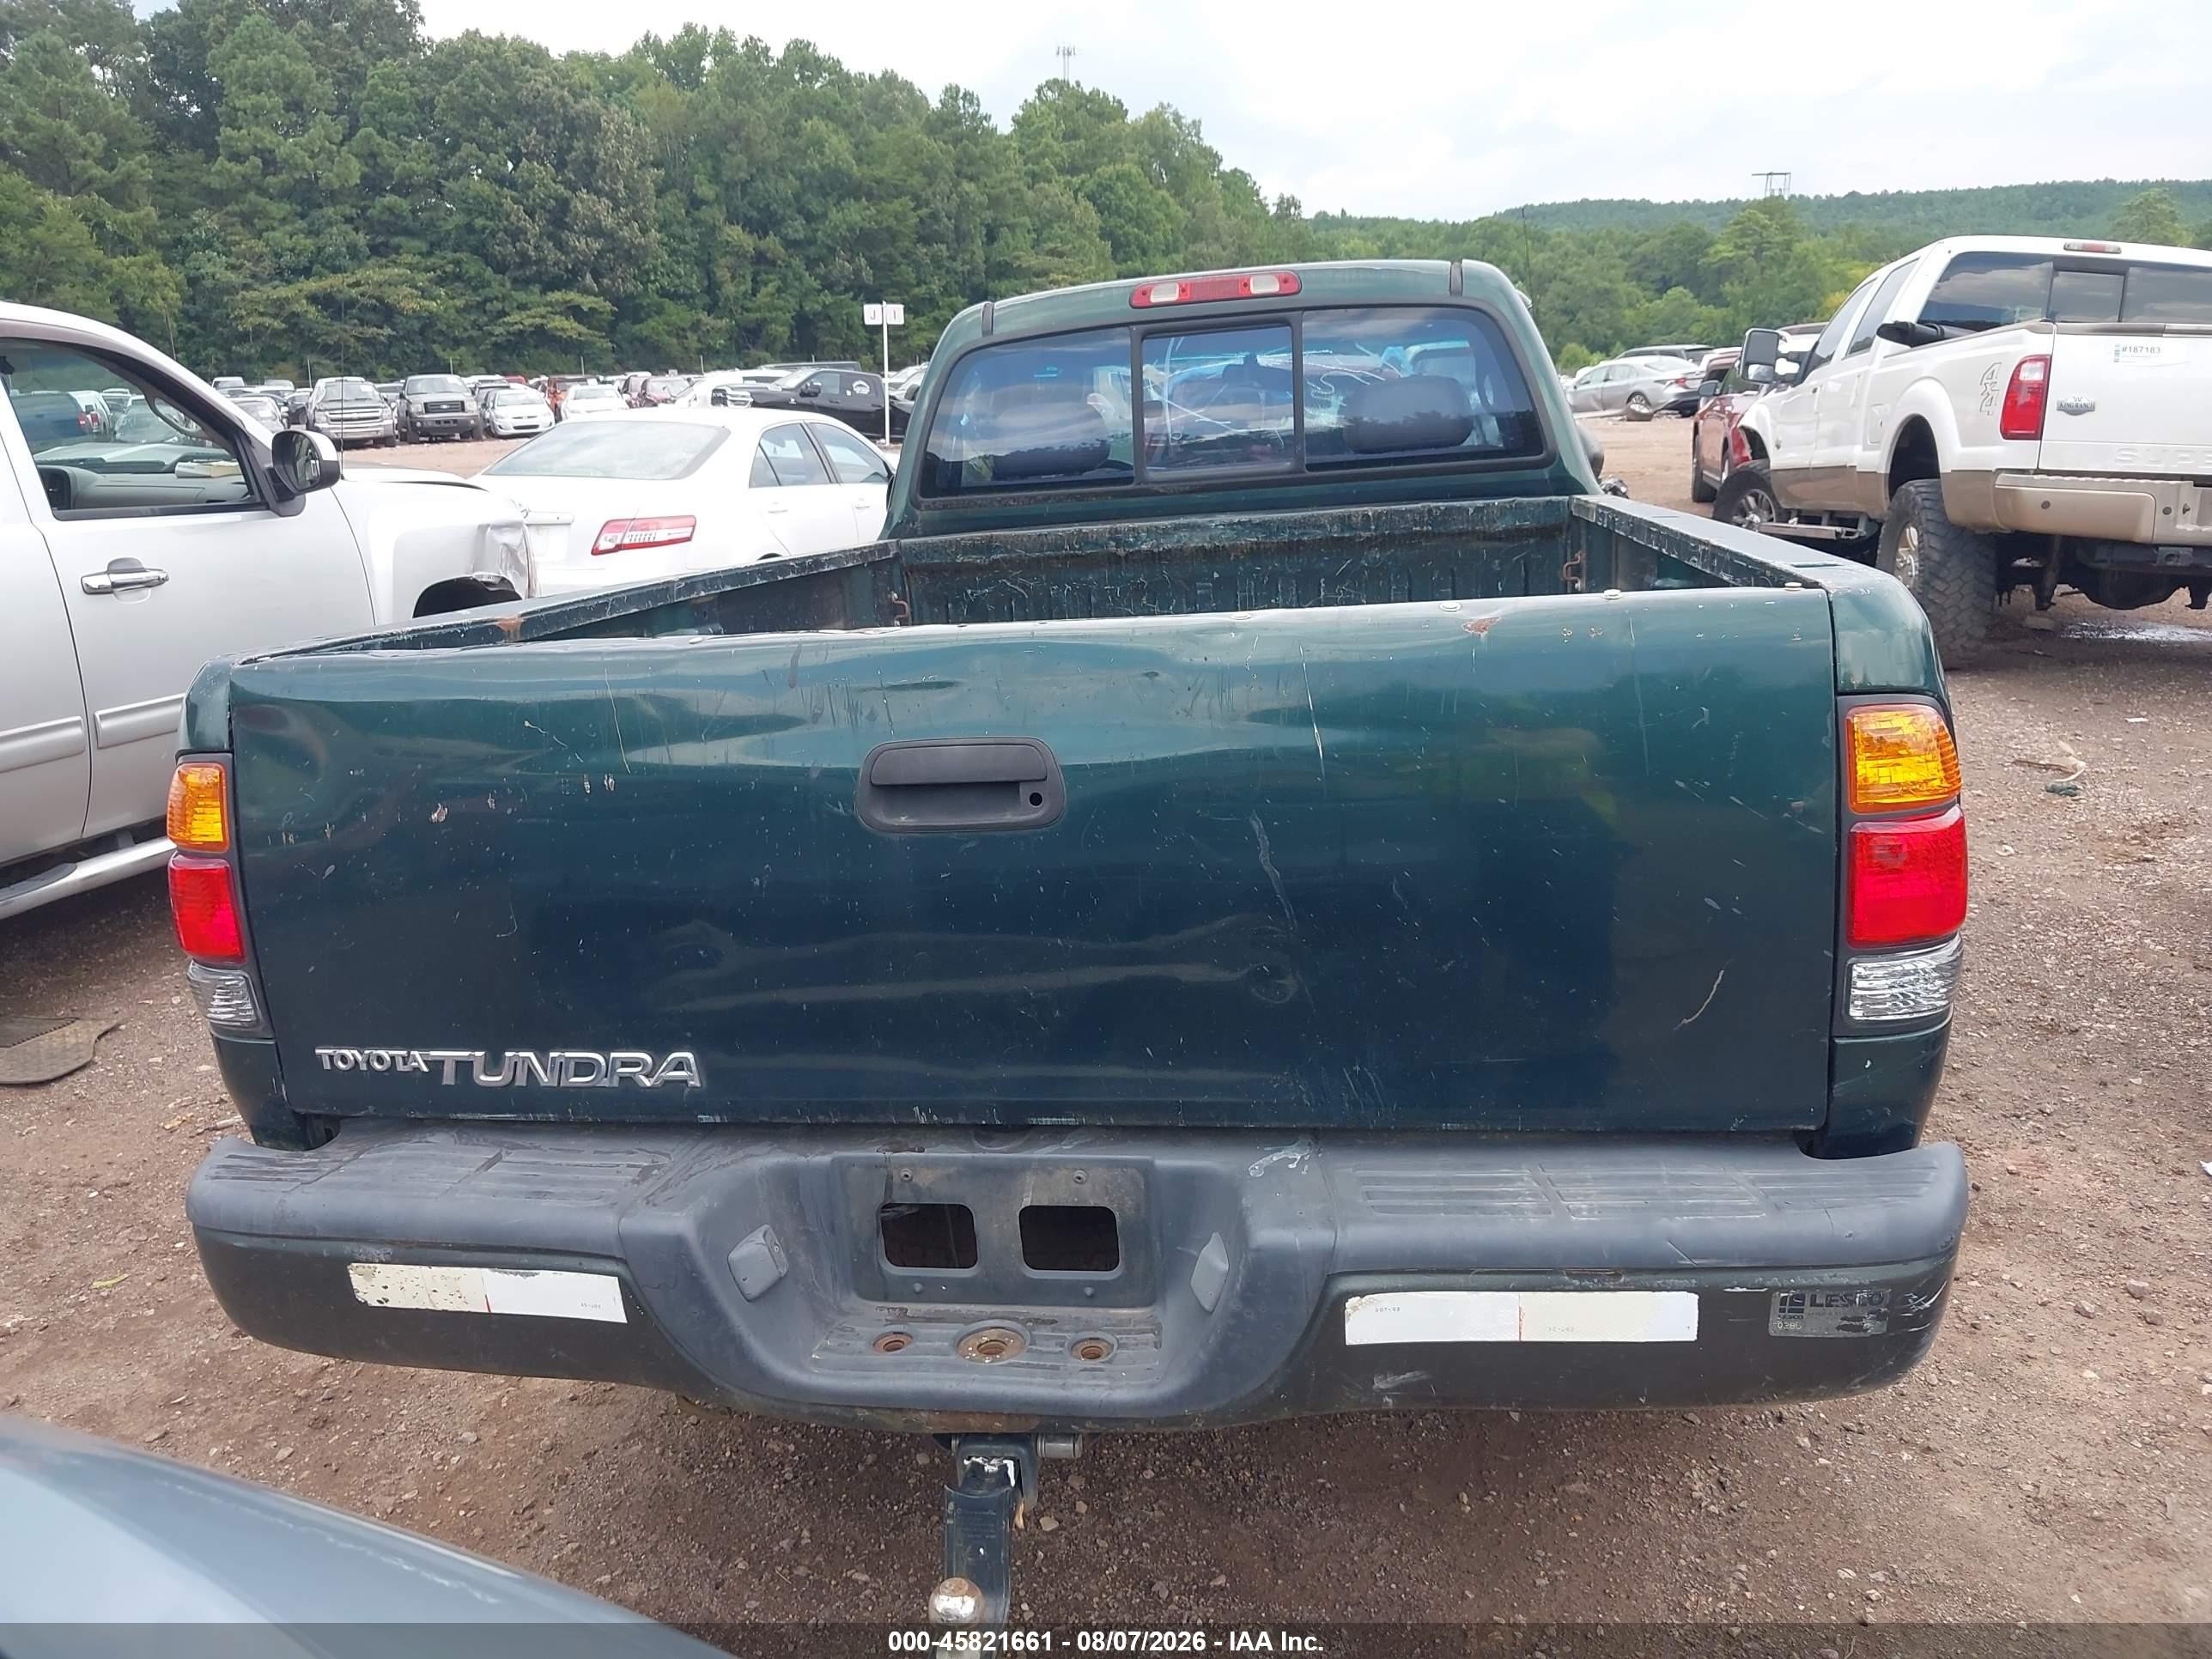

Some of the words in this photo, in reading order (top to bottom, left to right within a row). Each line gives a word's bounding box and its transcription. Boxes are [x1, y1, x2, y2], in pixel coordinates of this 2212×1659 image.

[870, 309, 876, 320] J
[2122, 345, 2161, 355] #187183
[314, 1047, 430, 1073] TOYOTA
[424, 1051, 702, 1088] TUNDRA
